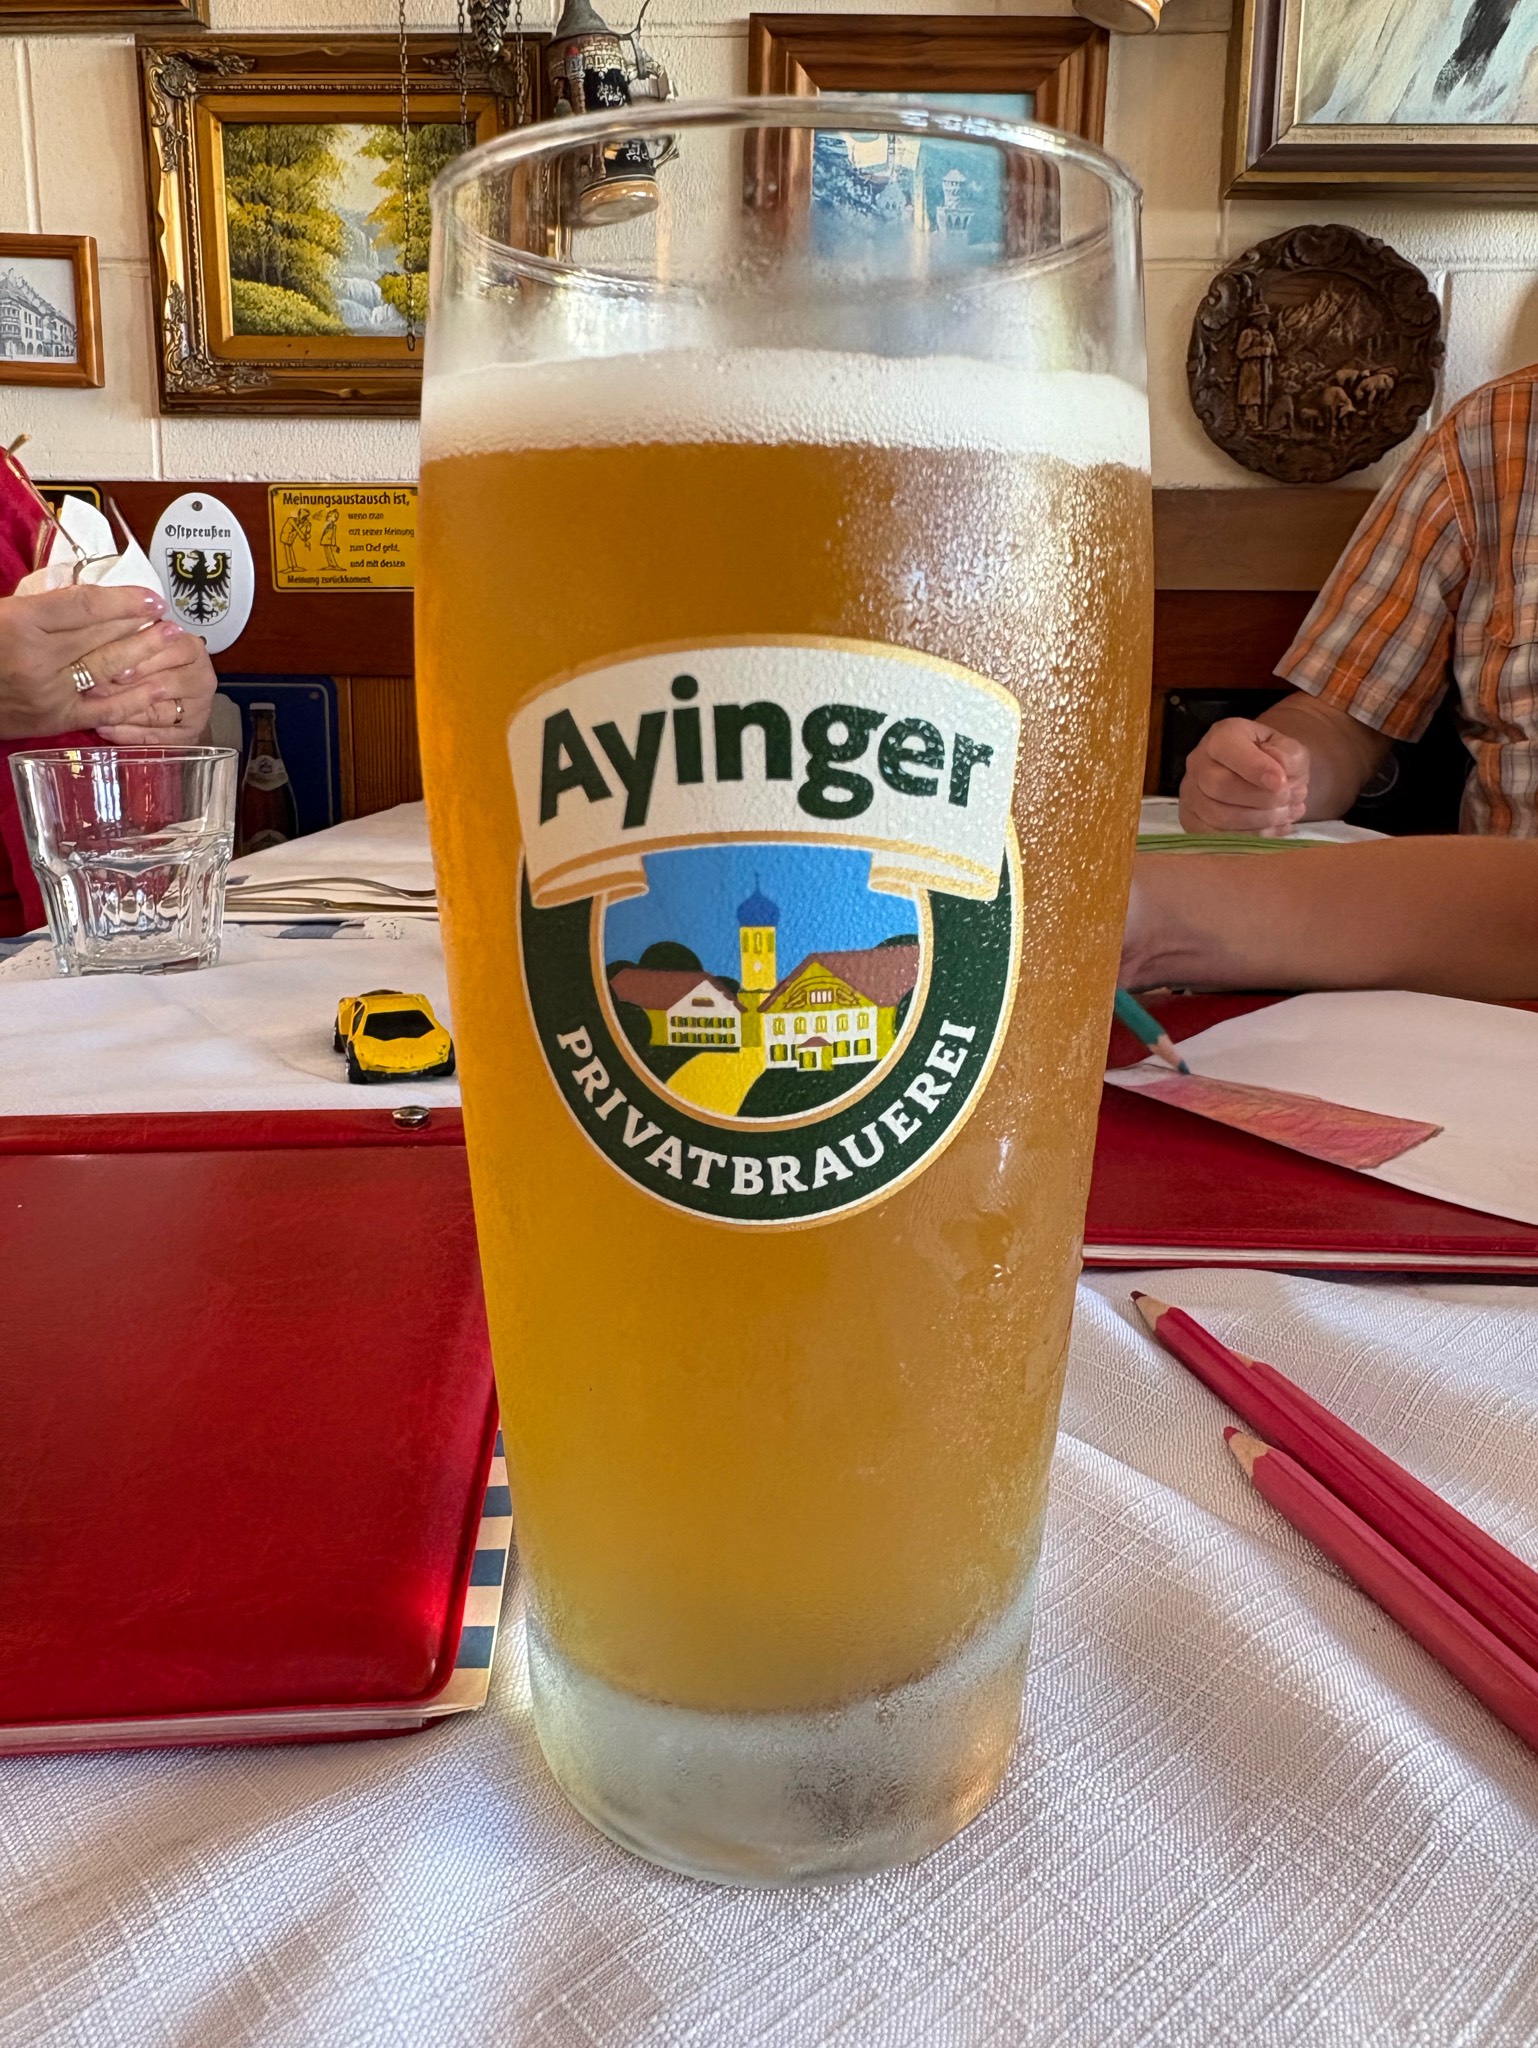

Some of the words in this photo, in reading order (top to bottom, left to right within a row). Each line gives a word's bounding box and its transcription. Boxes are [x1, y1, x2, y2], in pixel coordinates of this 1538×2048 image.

[282, 491, 391, 508] Meinungsaustausch
[393, 492, 410, 506] ist,
[350, 559, 365, 568] und
[380, 559, 406, 568] dessen
[287, 575, 320, 586] Meinung
[539, 674, 994, 829] Ayinger
[556, 1019, 978, 1196] PRIVATBRAUEREI
